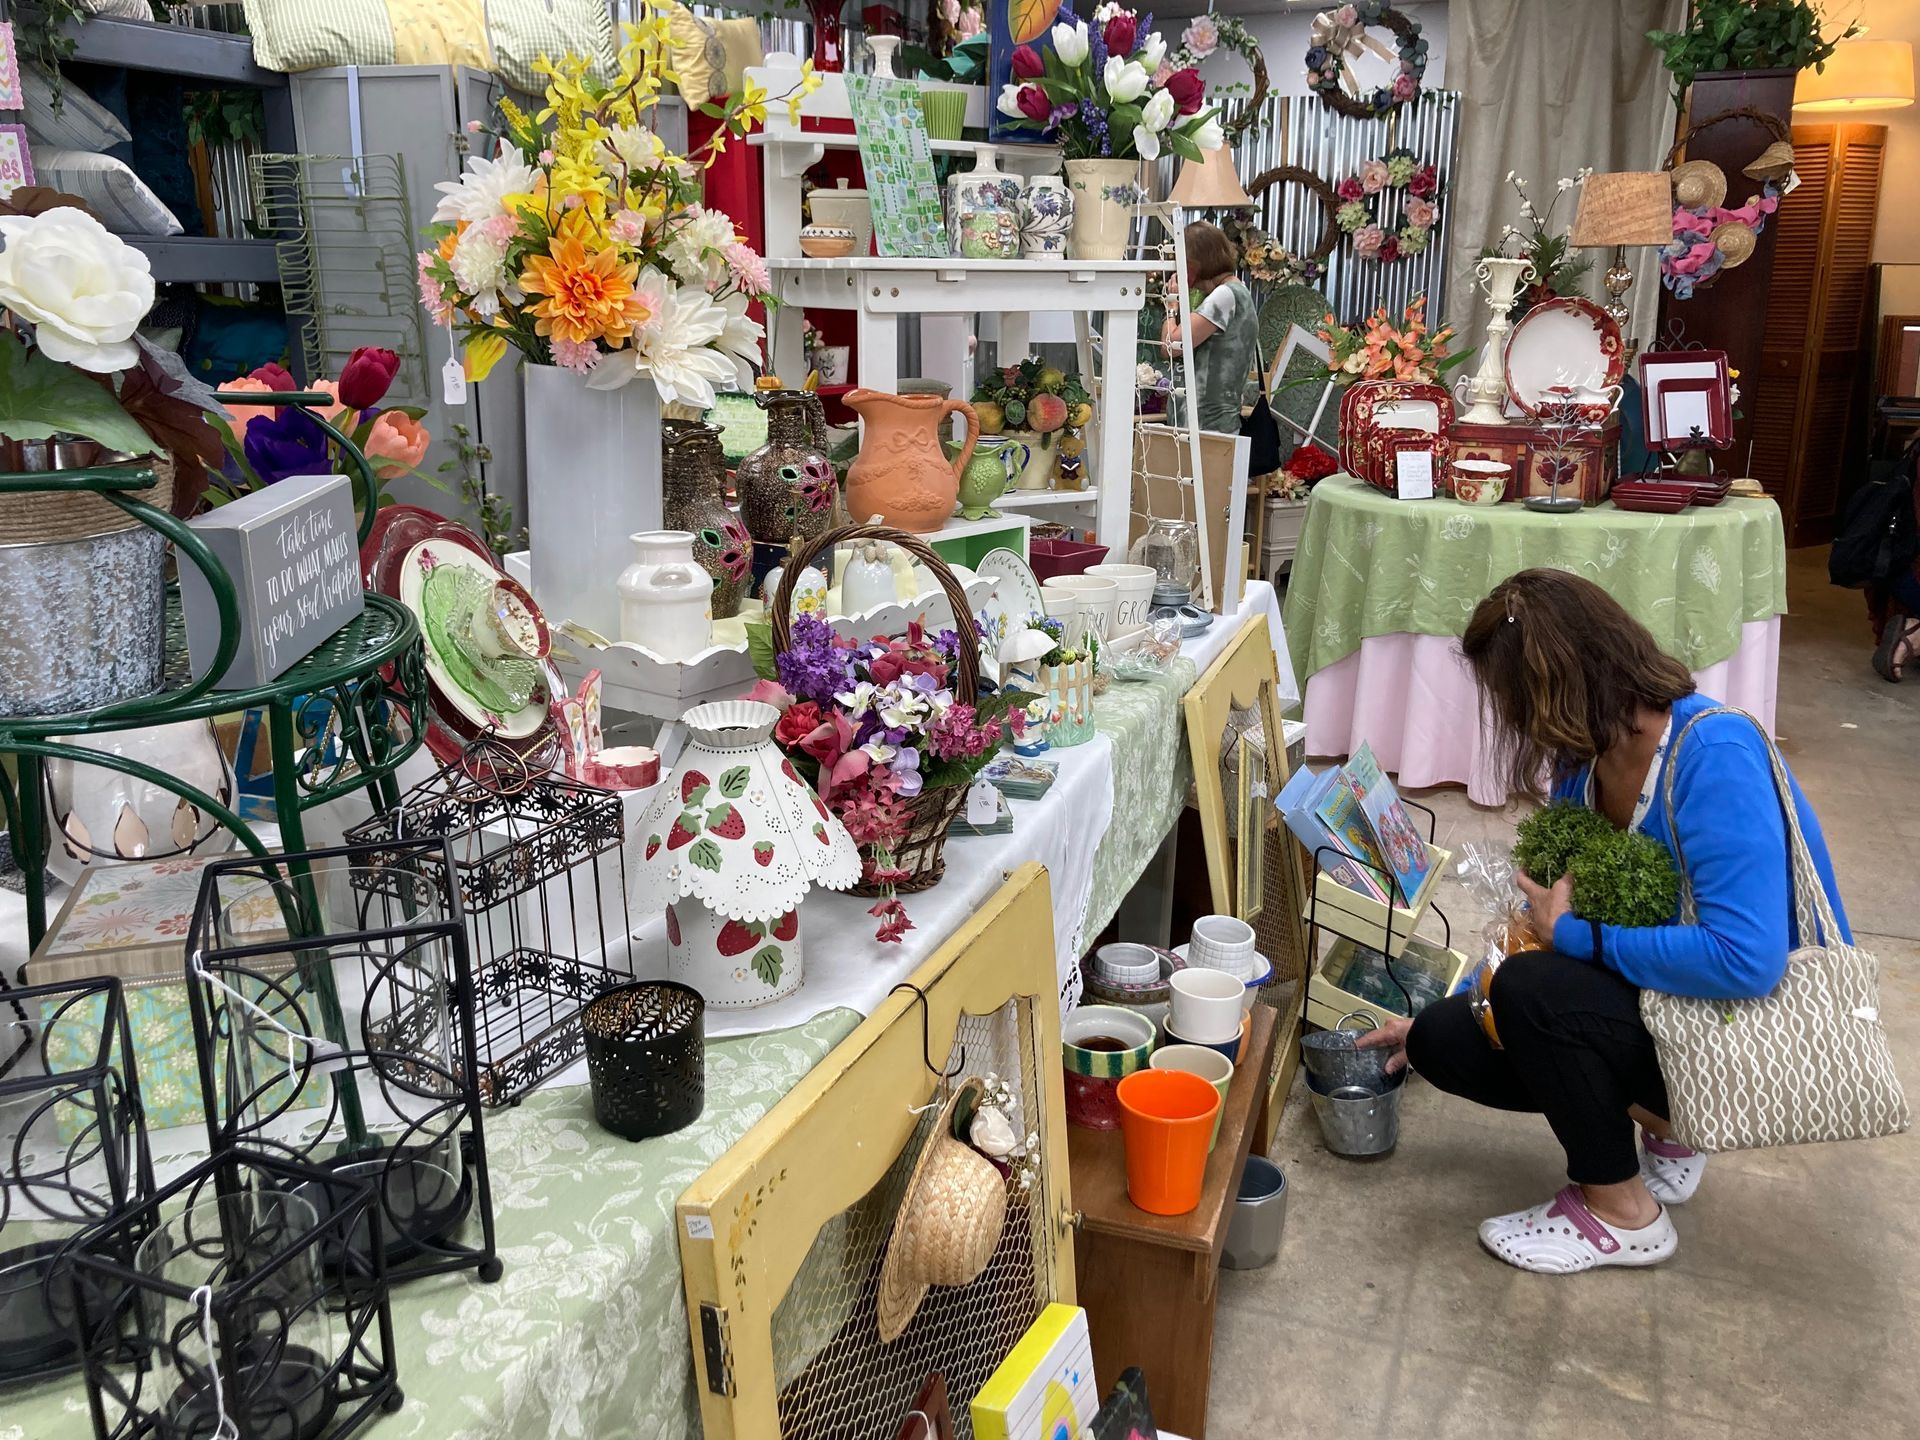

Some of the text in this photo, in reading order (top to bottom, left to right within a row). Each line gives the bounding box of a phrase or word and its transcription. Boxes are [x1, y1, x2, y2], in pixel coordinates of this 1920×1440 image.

[0, 158, 21, 180] es
[276, 508, 334, 559] take time
[265, 531, 349, 606] TO DO WHAT MAKES
[263, 559, 360, 669] your soul happy
